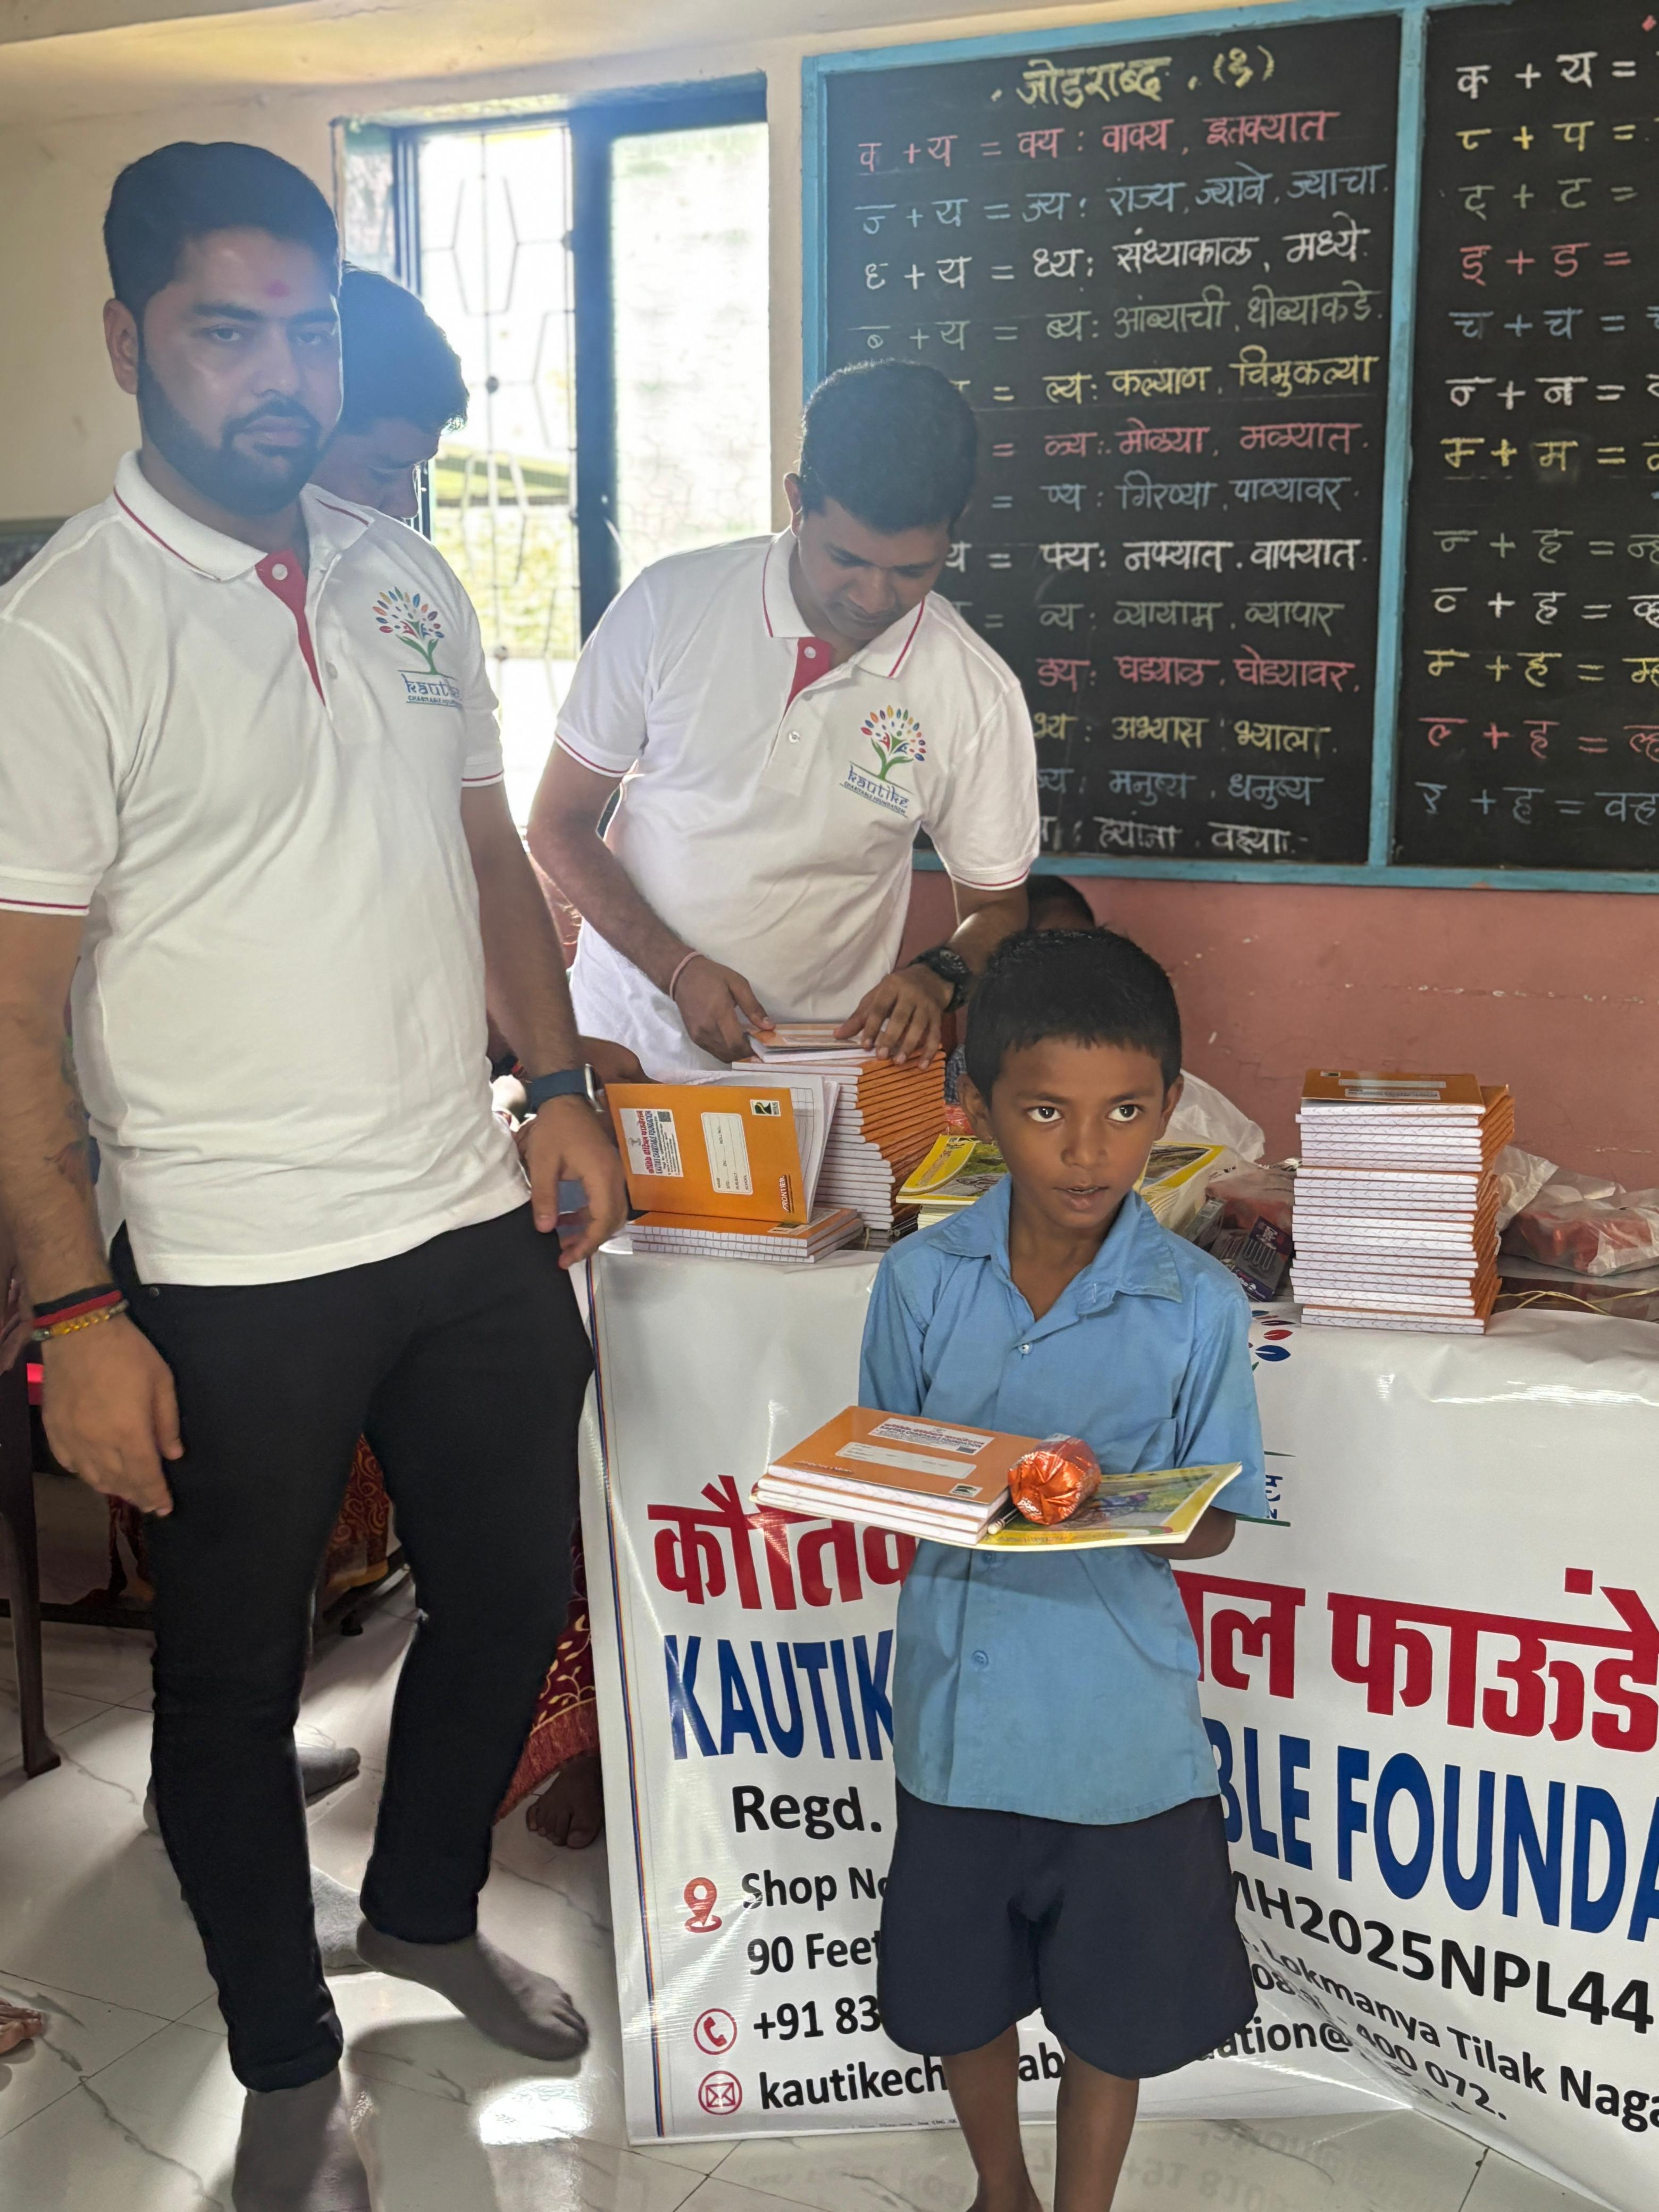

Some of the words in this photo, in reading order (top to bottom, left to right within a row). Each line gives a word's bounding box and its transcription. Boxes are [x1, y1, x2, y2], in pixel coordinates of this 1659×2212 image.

[1555, 51, 1598, 88] य
[927, 134, 959, 167] य
[1552, 120, 1595, 152] प
[1557, 177, 1593, 209] ट
[931, 198, 969, 228] य
[935, 255, 973, 289] य
[934, 320, 971, 350] य
[1543, 306, 1584, 340] च
[778, 1175, 790, 1213] FRONTIER
[732, 1784, 882, 1840] Regd.
[741, 1869, 837, 1912] Shop
[1260, 1938, 1441, 2048] Lokmanya
[1446, 2026, 1547, 2094] Tilak
[747, 1935, 794, 1976] 90
[1356, 2023, 1418, 2071] 400
[753, 2000, 825, 2041] +91
